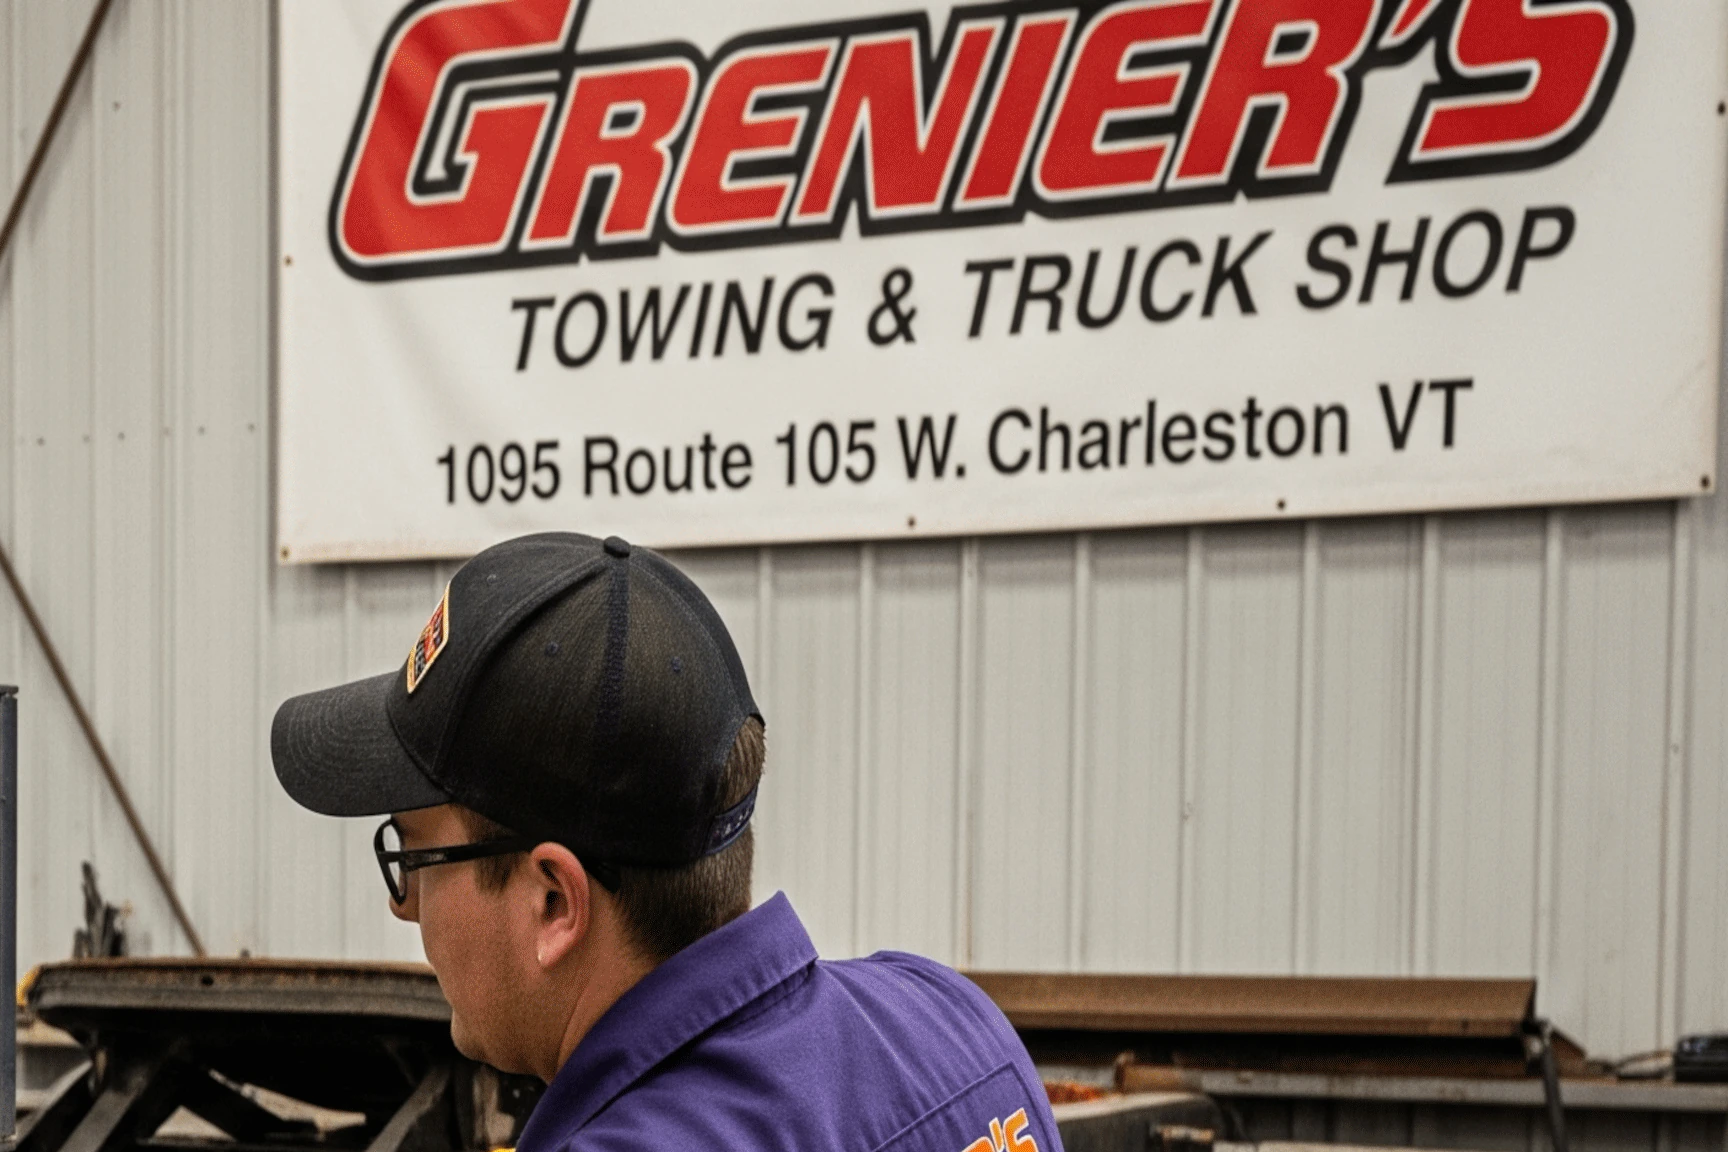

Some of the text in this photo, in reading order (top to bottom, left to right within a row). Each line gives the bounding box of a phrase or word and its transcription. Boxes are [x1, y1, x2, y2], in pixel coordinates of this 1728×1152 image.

[510, 204, 1577, 372] TOWING & TRUCK SHOP
[436, 378, 1474, 505] 1095 Route 105 W. Charleston VT
